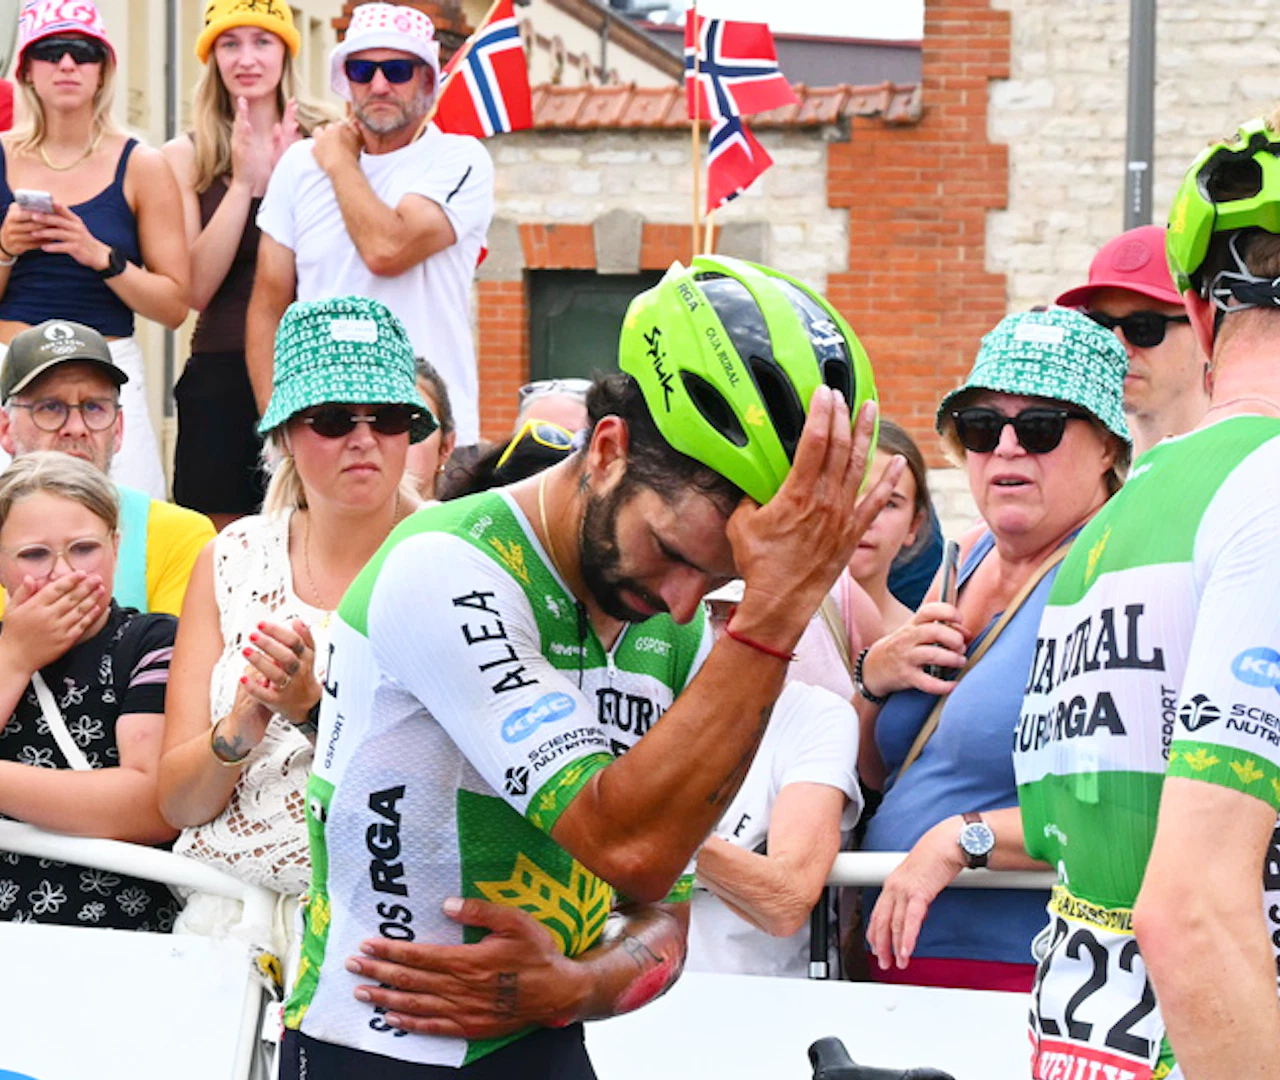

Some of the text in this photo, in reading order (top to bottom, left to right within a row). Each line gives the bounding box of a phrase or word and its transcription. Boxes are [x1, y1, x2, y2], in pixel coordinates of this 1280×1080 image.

[643, 326, 675, 413] Spiuk
[719, 350, 740, 388] RURAL
[452, 590, 539, 694] ALEA
[634, 636, 672, 657] GSPORT
[324, 712, 346, 770] GSPORT
[505, 698, 570, 737] KMC
[1054, 692, 1127, 741] RGA
[1161, 684, 1177, 761] GSPORT
[366, 785, 408, 898] RGA
